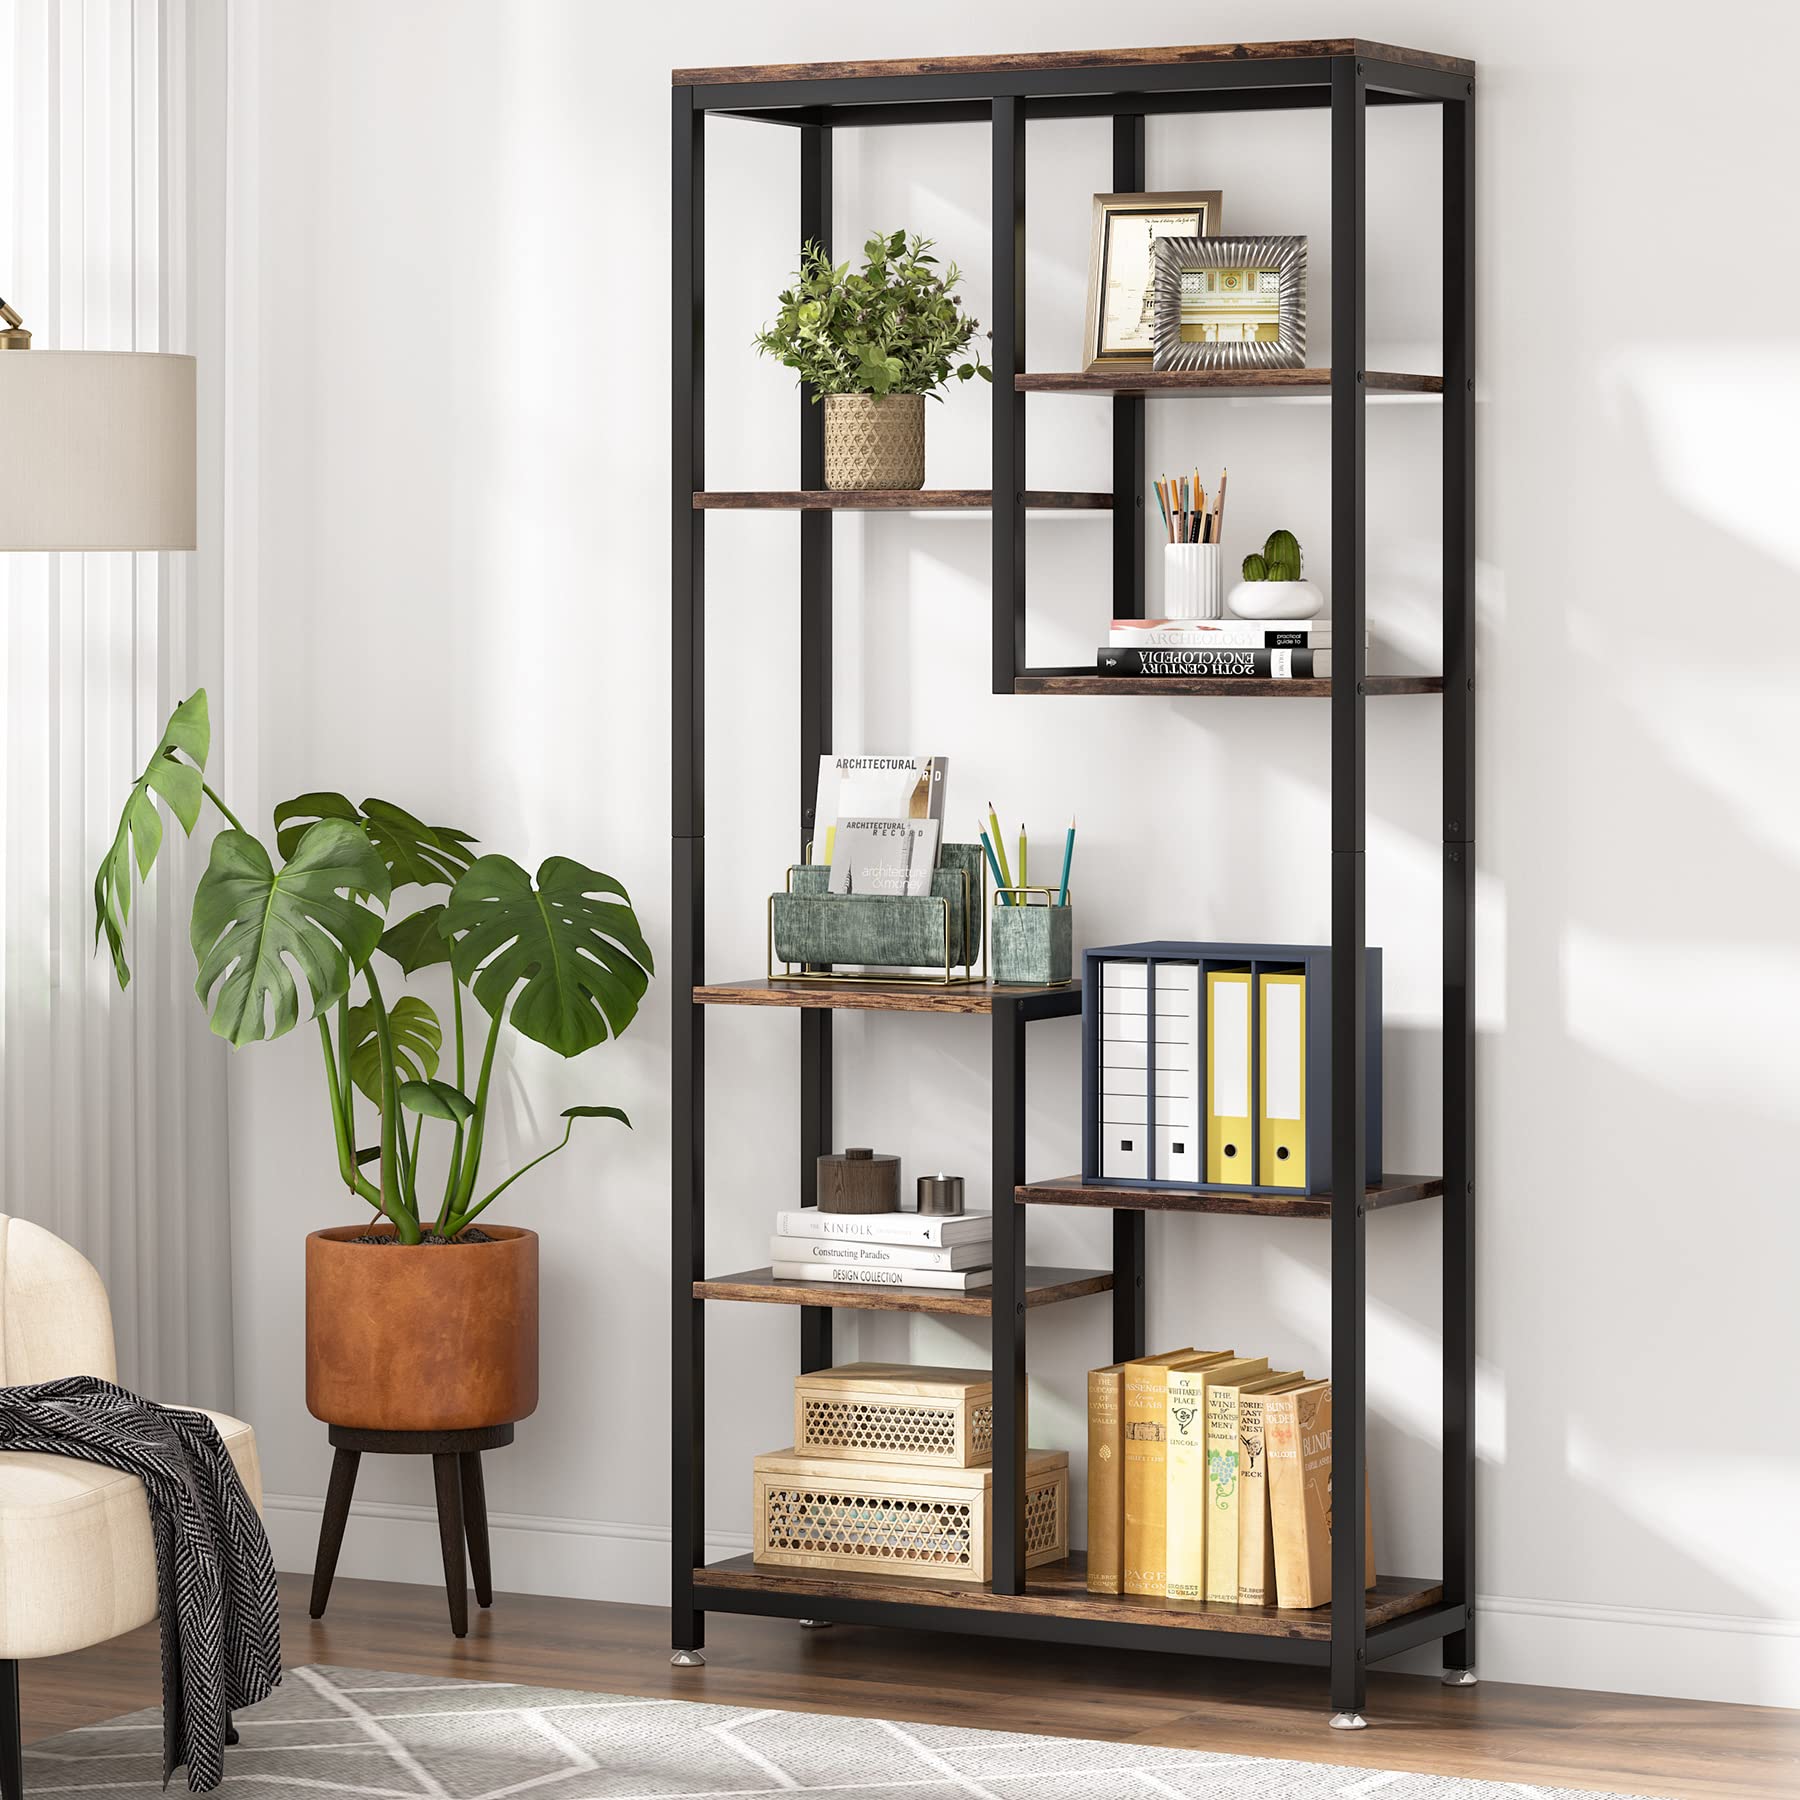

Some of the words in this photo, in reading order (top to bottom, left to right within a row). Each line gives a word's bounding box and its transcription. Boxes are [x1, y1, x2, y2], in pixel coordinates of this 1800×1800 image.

[1137, 651, 1255, 664] ENCYCLOPEDIA
[1139, 663, 1208, 675] CENTURY
[836, 758, 918, 770] ARCHITECTURAL
[846, 821, 906, 830] ARCHITECTURAL
[872, 829, 924, 838] RECORD
[862, 862, 928, 878] architecture
[823, 1222, 873, 1237] KINFOLK
[812, 1246, 859, 1261] Constructing
[832, 1268, 859, 1281] DESIGN
[860, 1270, 903, 1284] COLLECTION
[1213, 1392, 1232, 1400] THE
[1173, 1397, 1196, 1405] PLACE
[1209, 1400, 1236, 1409] WINE
[1240, 1409, 1262, 1417] EAST
[1211, 1421, 1234, 1430] MENT
[1241, 1417, 1261, 1425] AND
[1240, 1425, 1264, 1433] WEST
[1240, 1469, 1263, 1478] PECK
[1125, 1568, 1167, 1582] PAGE
